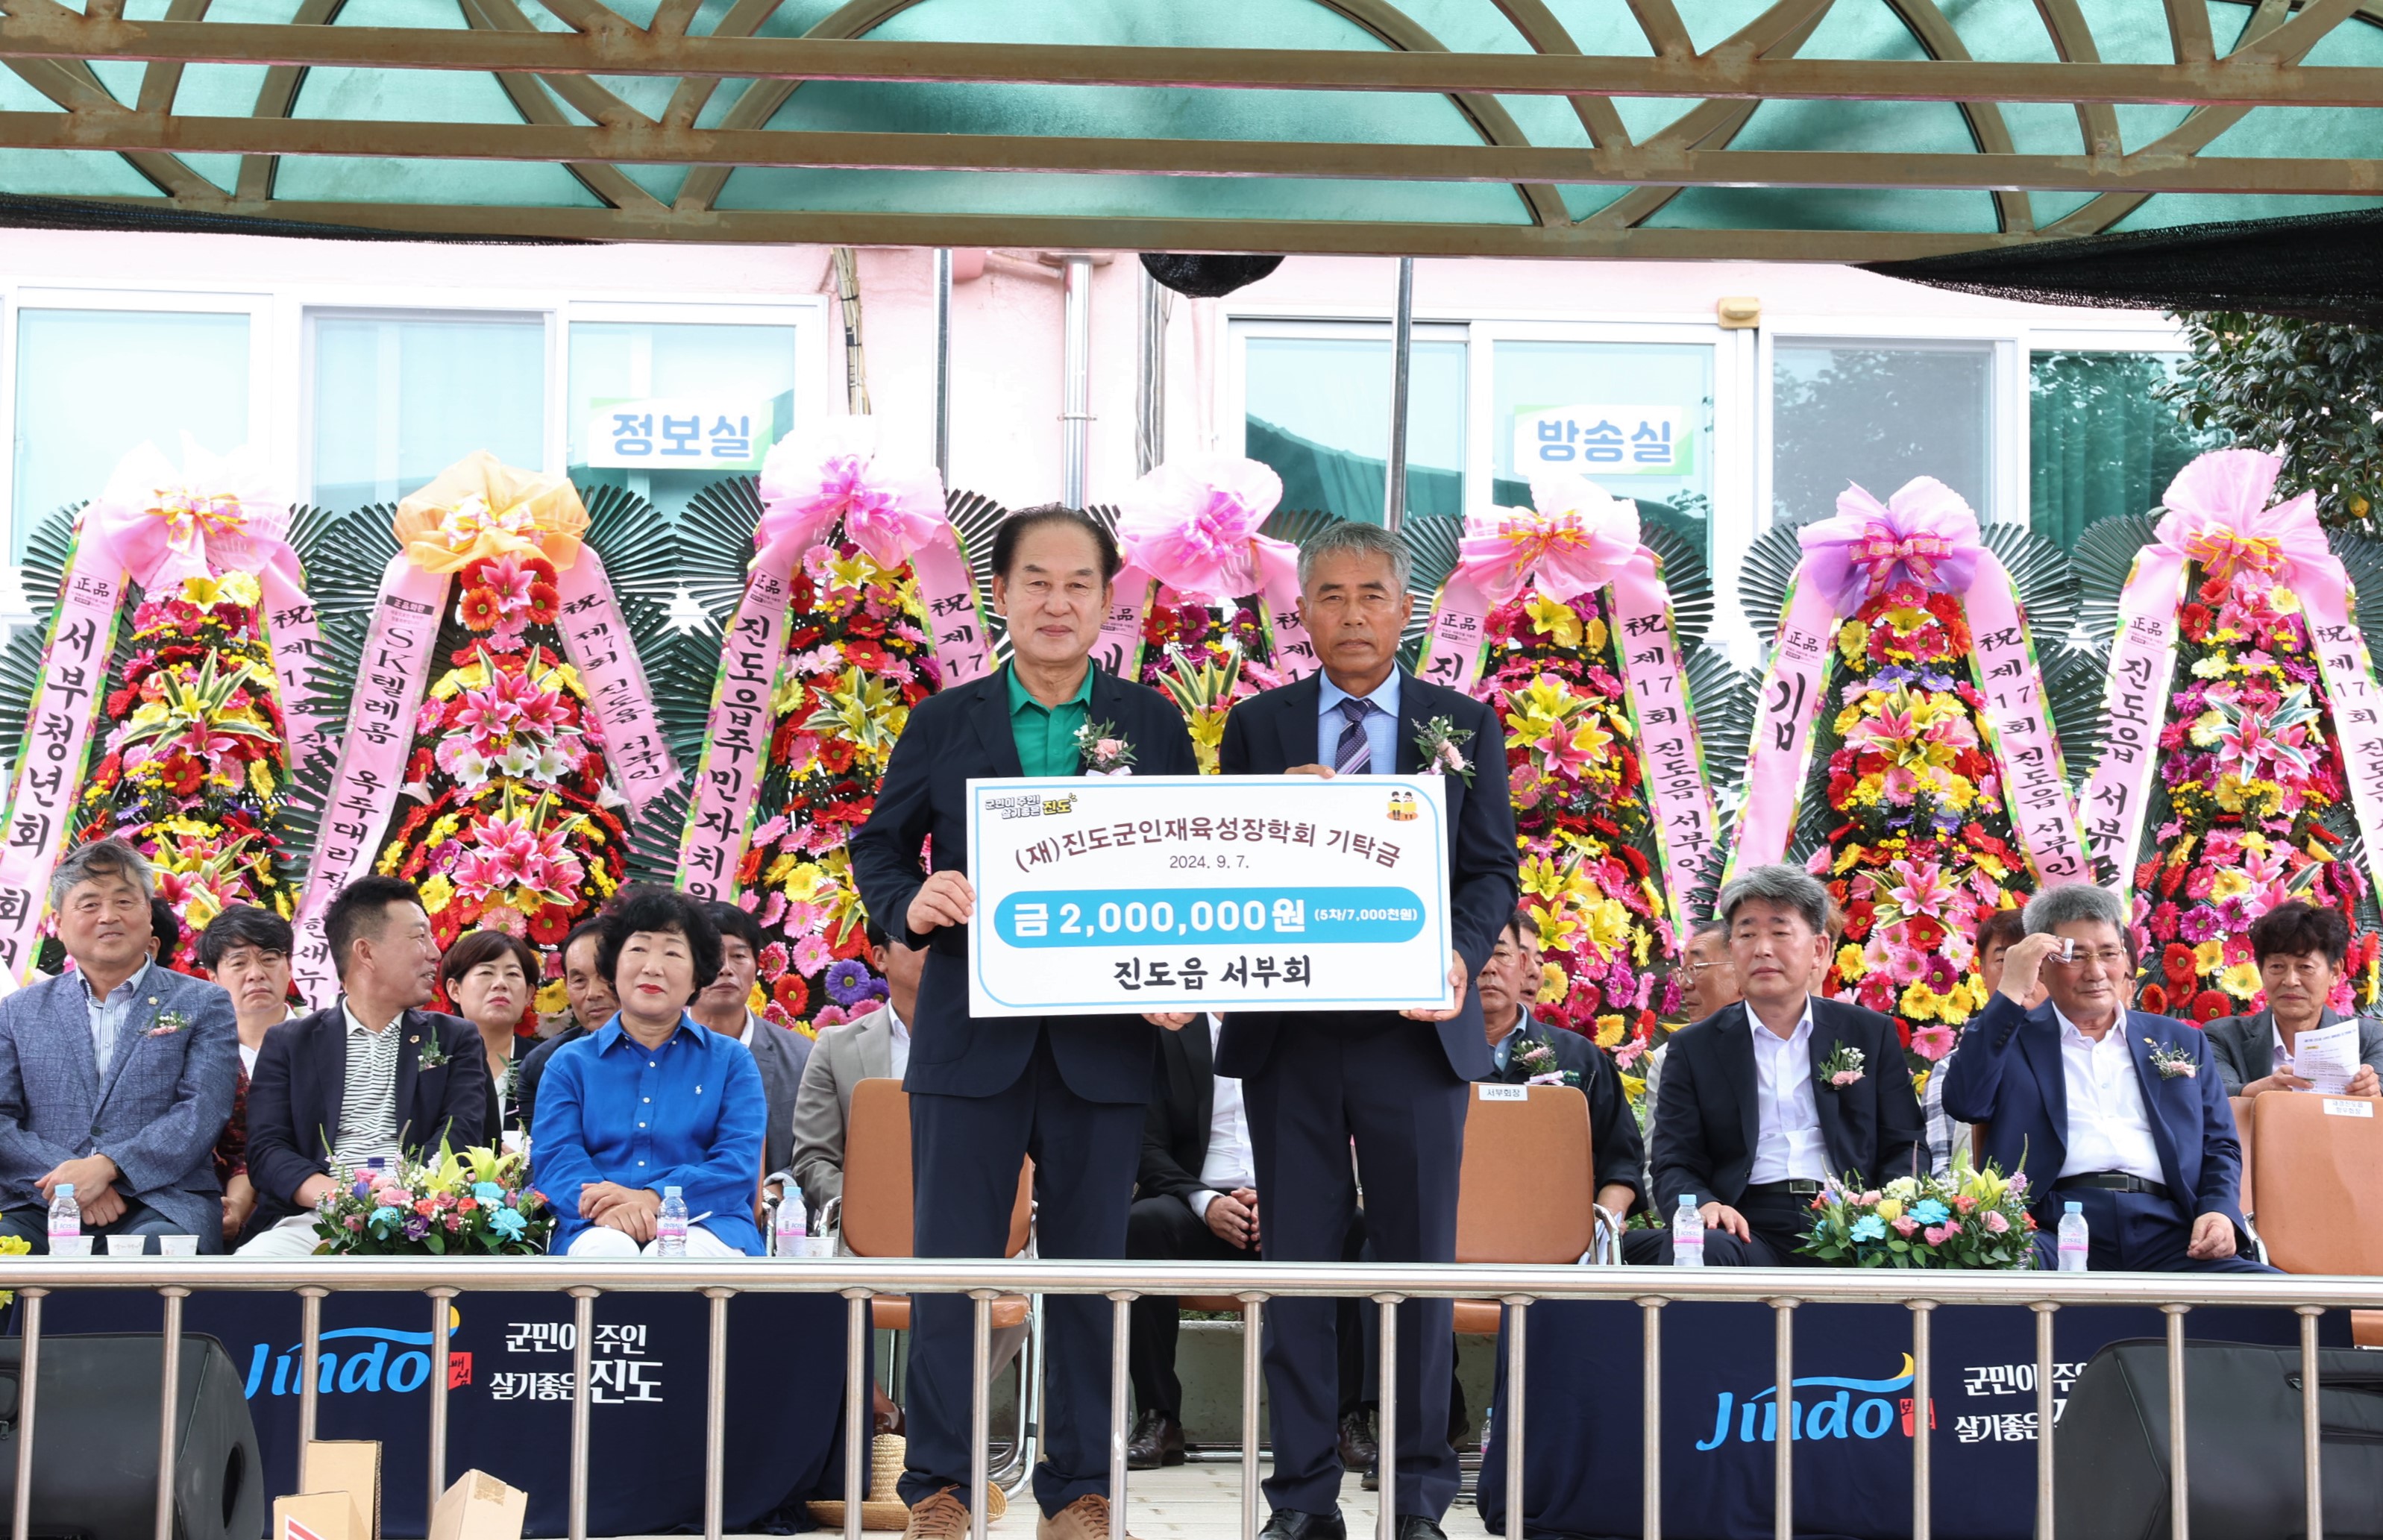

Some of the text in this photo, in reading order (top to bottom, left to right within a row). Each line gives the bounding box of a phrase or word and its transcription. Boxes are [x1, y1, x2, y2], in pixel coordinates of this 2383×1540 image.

[612, 414, 750, 457] 정보실
[1538, 420, 1671, 462] 방송실
[74, 577, 110, 597] 正品
[930, 593, 974, 617] 祝
[1440, 614, 1476, 631] 正品
[1624, 614, 1669, 638] 祝
[2130, 616, 2163, 637] 正品
[2315, 625, 2353, 643] 祝
[562, 593, 606, 615] 祝
[595, 679, 646, 724] 진도읍
[1786, 631, 1819, 653] 正品
[1630, 647, 1676, 726] 제17회
[2108, 656, 2152, 764] 진도읍
[9, 617, 95, 859] 서부청년회
[1979, 627, 2086, 877] 祝 제17회 진도읍 서부인
[1650, 738, 1700, 801] 진도읍
[985, 794, 1040, 810] 군민이 주인!
[1002, 799, 1072, 819] 살기좋은 진도
[1015, 817, 1401, 873] (재)진도군인재육성장학회 기탁금
[1169, 855, 1249, 869] 2024. 9. 7.
[1314, 907, 1419, 923] (5차/7,000천원)
[1113, 955, 1311, 990] 진도읍 서부회
[1486, 1089, 1520, 1097] 서부회장
[594, 1323, 647, 1355] 주인
[590, 1359, 663, 1404] 진도
[1963, 1363, 2038, 1397] 군민이
[1695, 1390, 1894, 1451] Jindo
